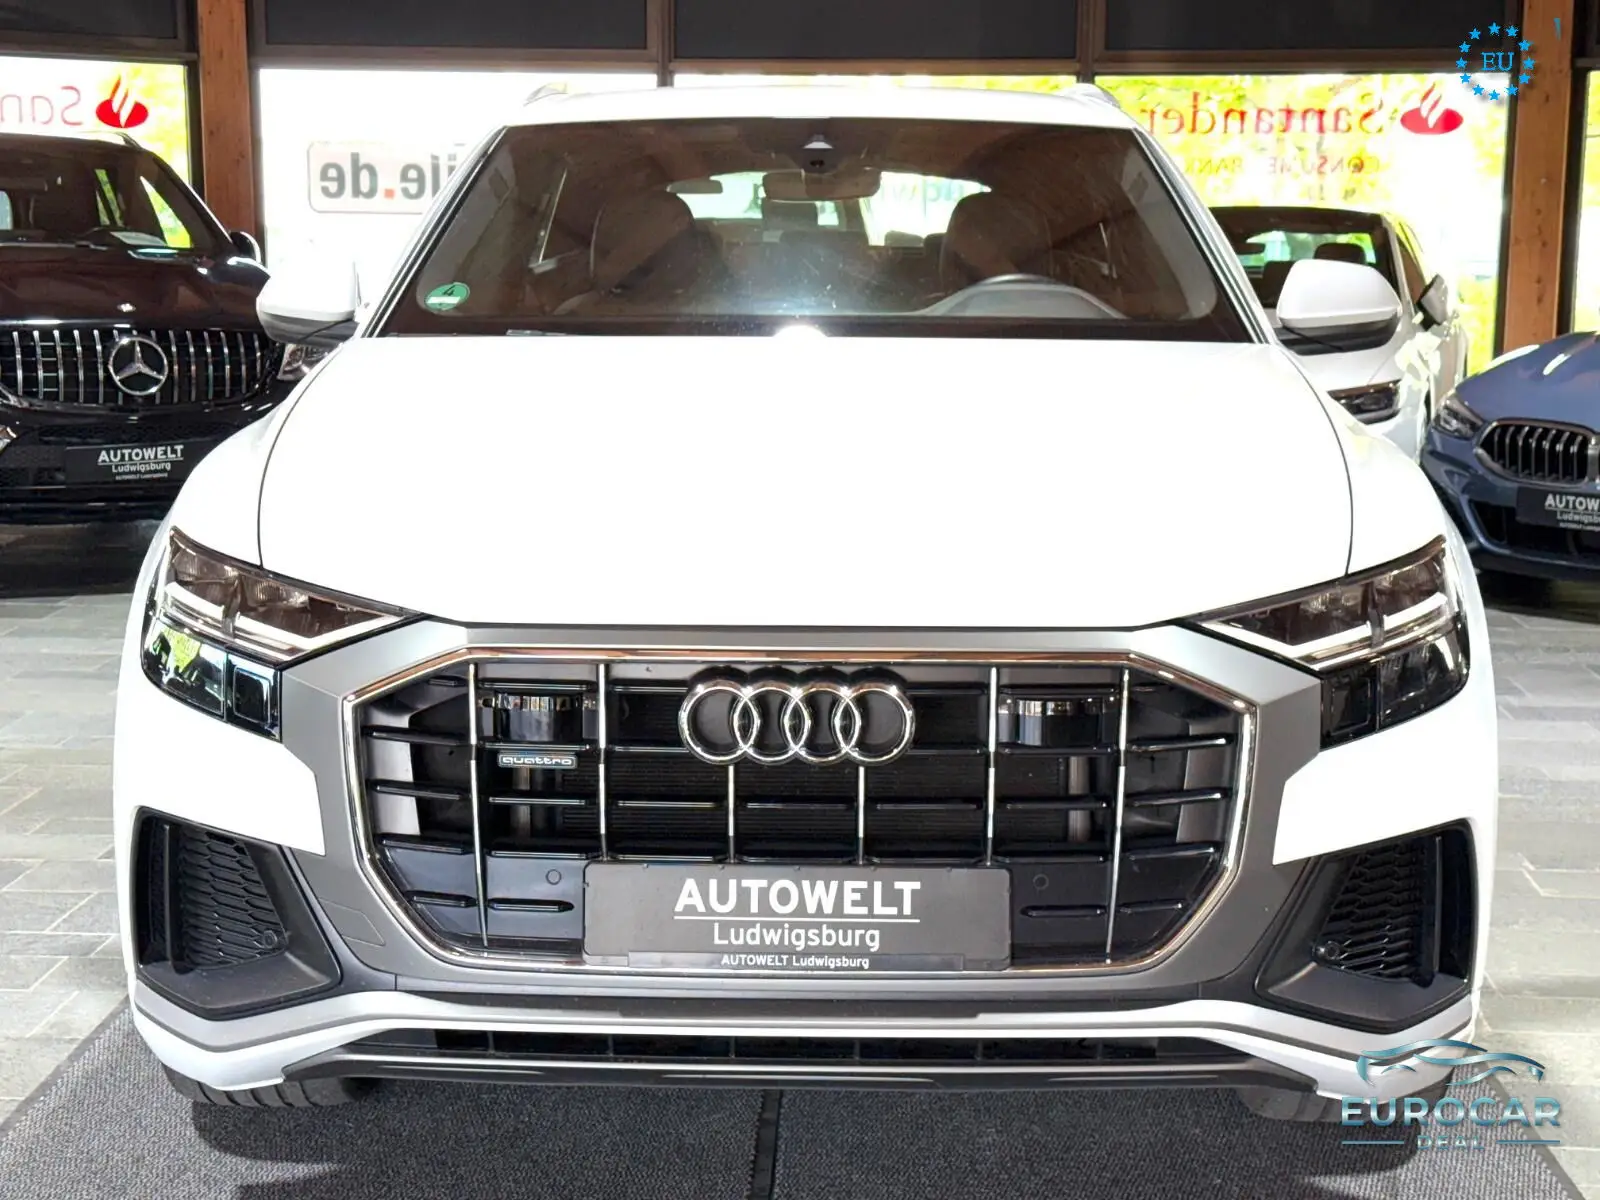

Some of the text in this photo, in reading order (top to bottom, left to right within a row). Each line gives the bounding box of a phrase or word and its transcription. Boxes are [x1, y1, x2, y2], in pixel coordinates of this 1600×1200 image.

[97, 444, 184, 463] AUTOWELT
[111, 461, 172, 473] Ludwigsburg
[501, 756, 573, 766] quattro
[674, 878, 921, 916] AUTOWELT
[712, 922, 881, 952] Ludwigsburg
[721, 954, 870, 970] AUTOWELT Ludwigsburg
